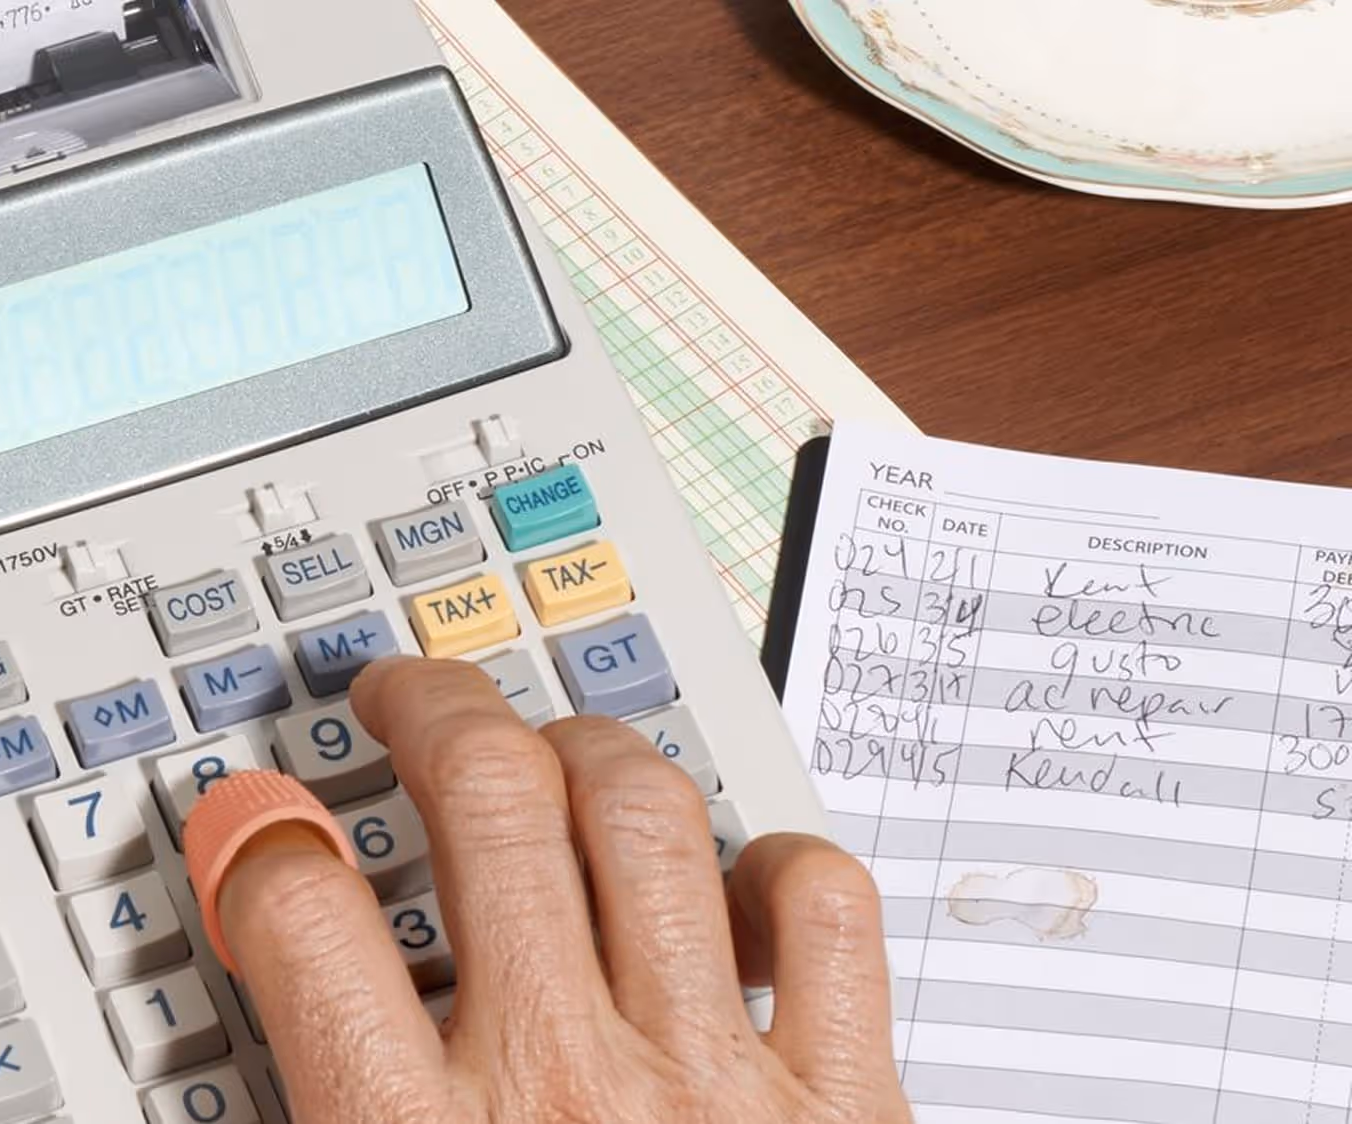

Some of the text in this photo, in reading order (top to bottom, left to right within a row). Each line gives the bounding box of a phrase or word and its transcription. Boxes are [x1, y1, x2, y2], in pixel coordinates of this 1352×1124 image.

[571, 439, 608, 461] ON
[426, 480, 466, 506] OFF
[505, 475, 583, 516] CHANGE
[869, 462, 934, 491] YEAR
[866, 495, 927, 518] CHECK
[877, 516, 910, 534] NO.
[393, 511, 466, 552] MGN
[941, 518, 989, 538] DATE
[1087, 535, 1208, 560] DESCRIPTION
[281, 547, 354, 587] SELL
[59, 574, 159, 617] GT RATE
[113, 592, 151, 617] SET
[166, 580, 238, 623] COST
[426, 590, 497, 627] TAX+
[316, 626, 378, 664] M+
[582, 632, 639, 674] GT
[307, 715, 354, 763] 9
[66, 790, 104, 840] 7
[351, 815, 397, 861] 6
[107, 890, 148, 935] 4
[392, 907, 439, 951] 3
[146, 987, 179, 1029] 1
[180, 1082, 228, 1124] 0
